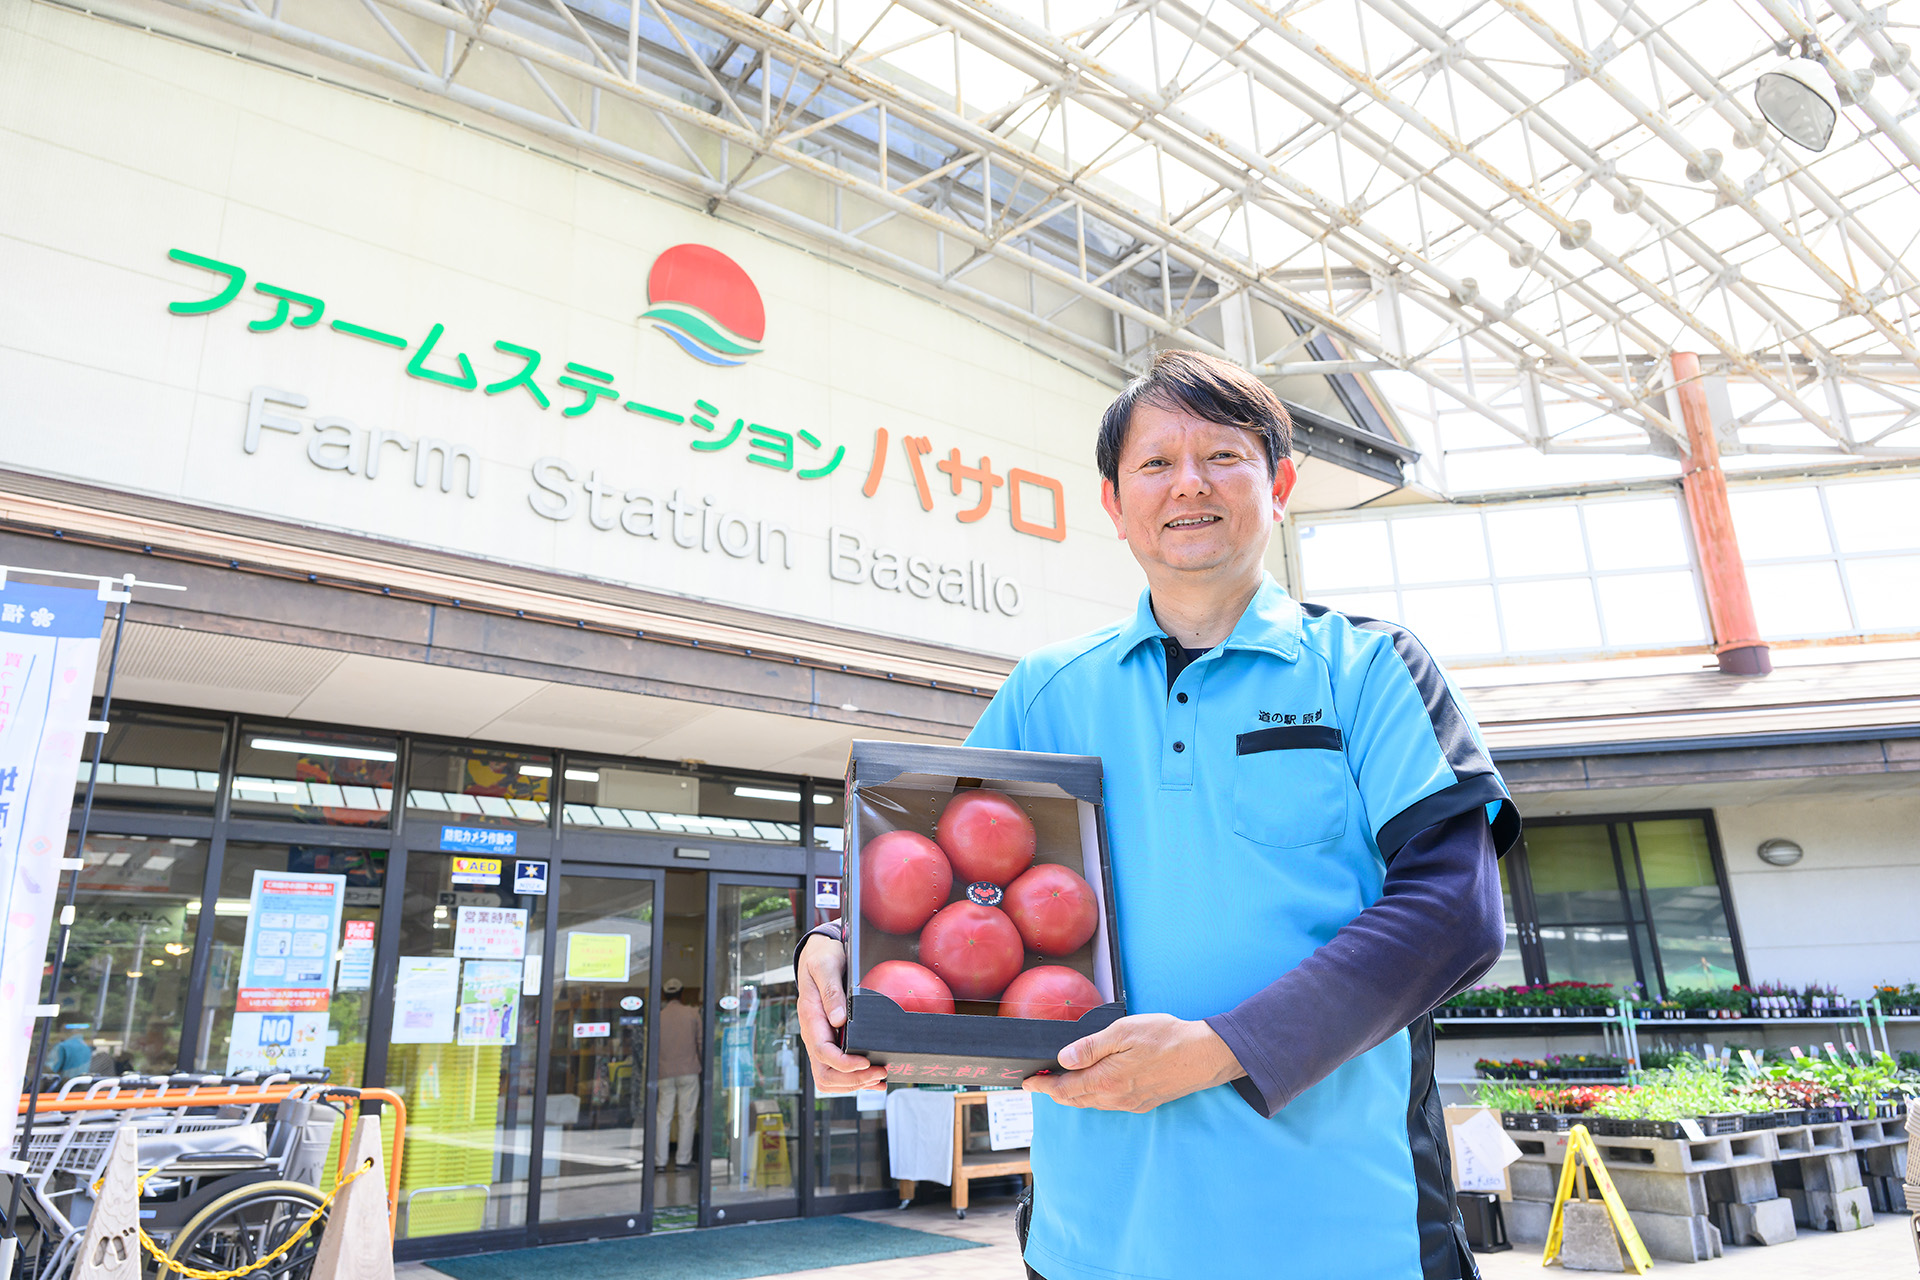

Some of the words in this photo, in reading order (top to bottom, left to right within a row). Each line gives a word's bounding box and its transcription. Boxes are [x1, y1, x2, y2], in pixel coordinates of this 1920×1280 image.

[168, 248, 846, 479] ファームステーション
[863, 427, 1066, 542] バサロ
[243, 385, 480, 498] Farm
[528, 457, 795, 569] Station
[829, 525, 1024, 617] Basallo
[1258, 710, 1297, 726] 道の駅
[469, 862, 497, 872] AED
[465, 911, 518, 924] 営業時間
[261, 1019, 292, 1042] NO
[886, 1063, 1052, 1079] 桃太郎と
